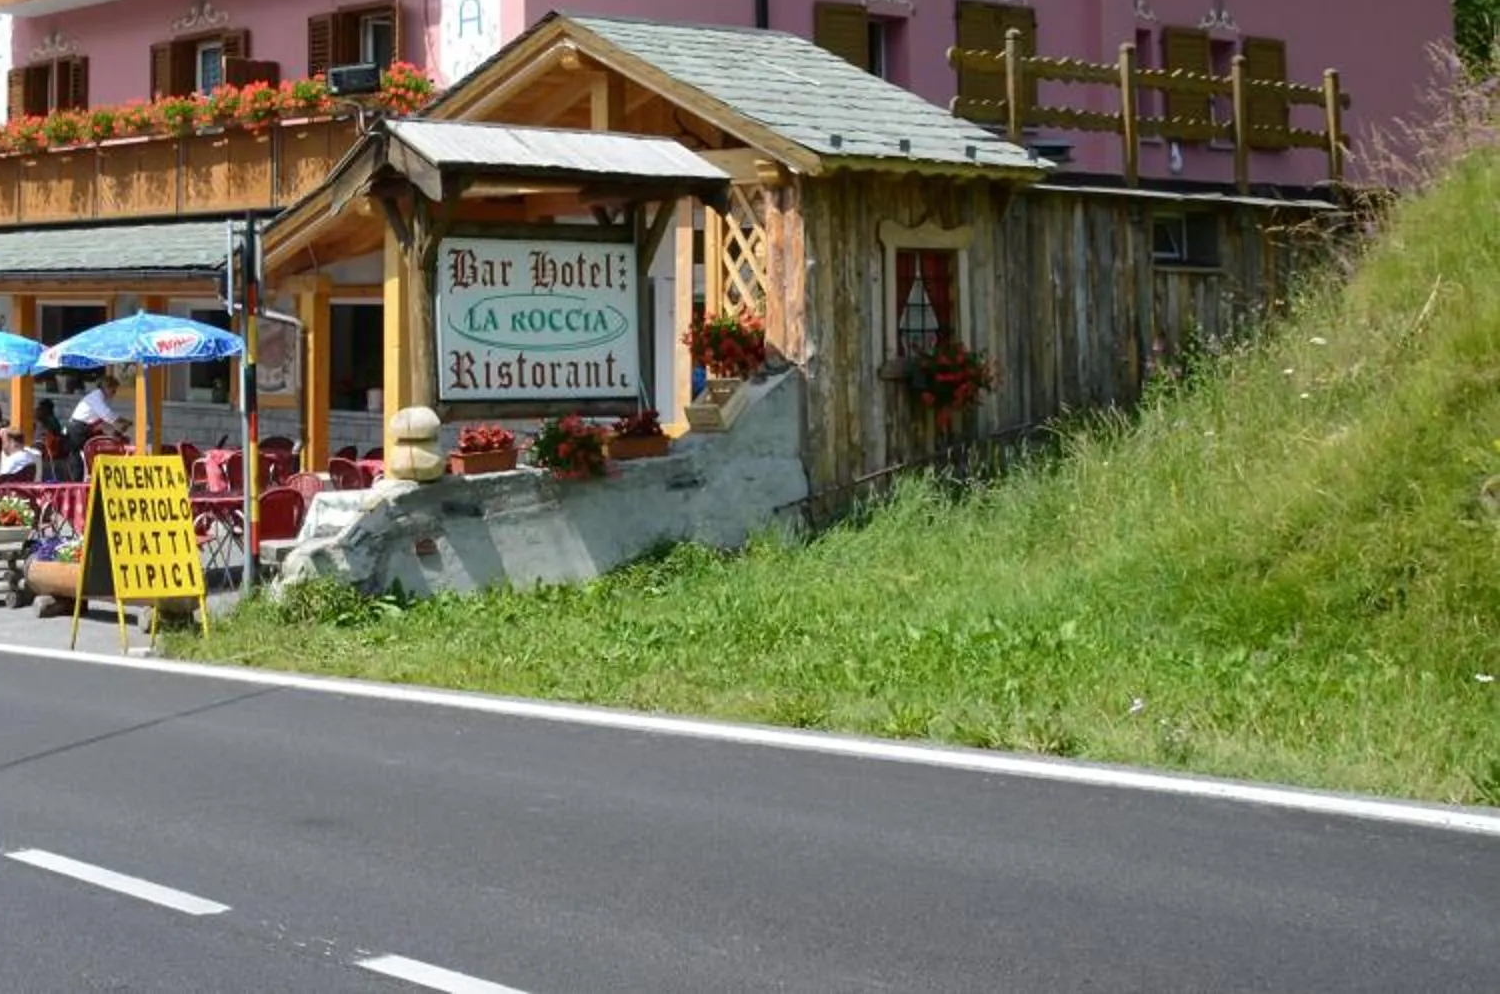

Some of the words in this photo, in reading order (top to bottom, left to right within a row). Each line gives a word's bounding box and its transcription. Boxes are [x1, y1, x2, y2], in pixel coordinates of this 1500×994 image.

[449, 249, 512, 294] Bar
[530, 251, 613, 294] Hotel
[463, 308, 499, 332] LA
[511, 308, 608, 333] ROCCIA
[103, 465, 175, 489] POLENTA
[107, 497, 190, 523] CAPRIOLO
[113, 529, 191, 555] PIATTI
[120, 562, 195, 589] TIPICI
